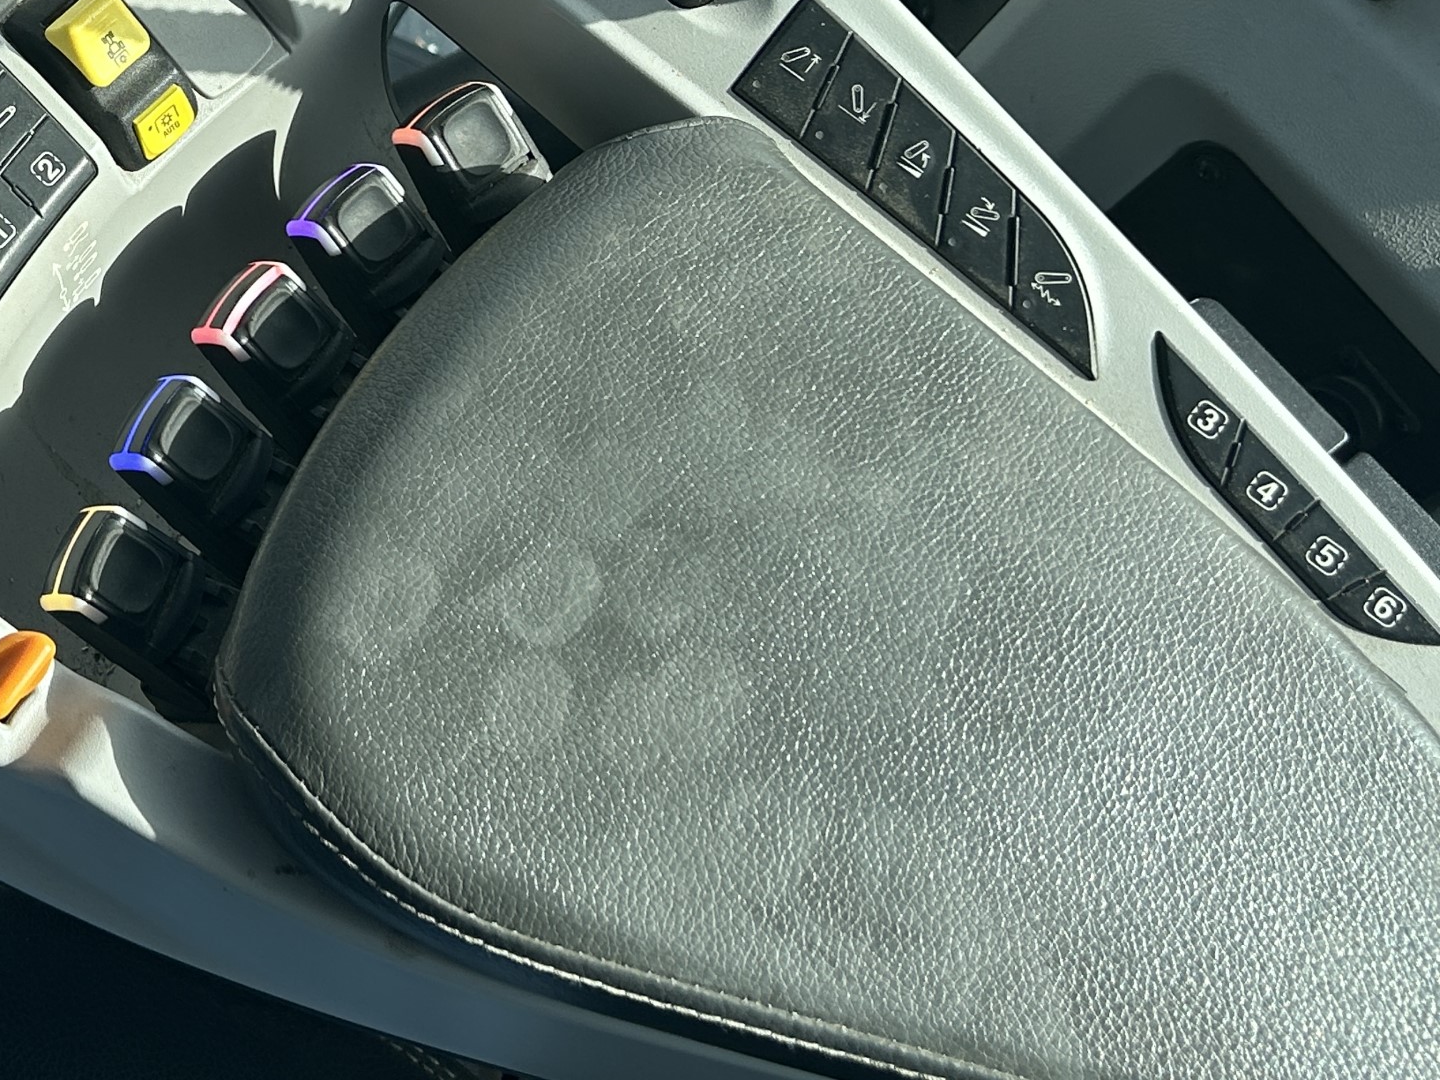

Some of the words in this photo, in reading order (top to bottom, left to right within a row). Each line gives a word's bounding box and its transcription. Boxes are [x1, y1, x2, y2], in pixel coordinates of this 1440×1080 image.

[163, 121, 180, 138] AUTO
[38, 159, 61, 181] 2
[1197, 408, 1220, 431] 3
[1256, 482, 1279, 502] 4
[1315, 544, 1340, 567] 5
[1373, 596, 1397, 618] 6
